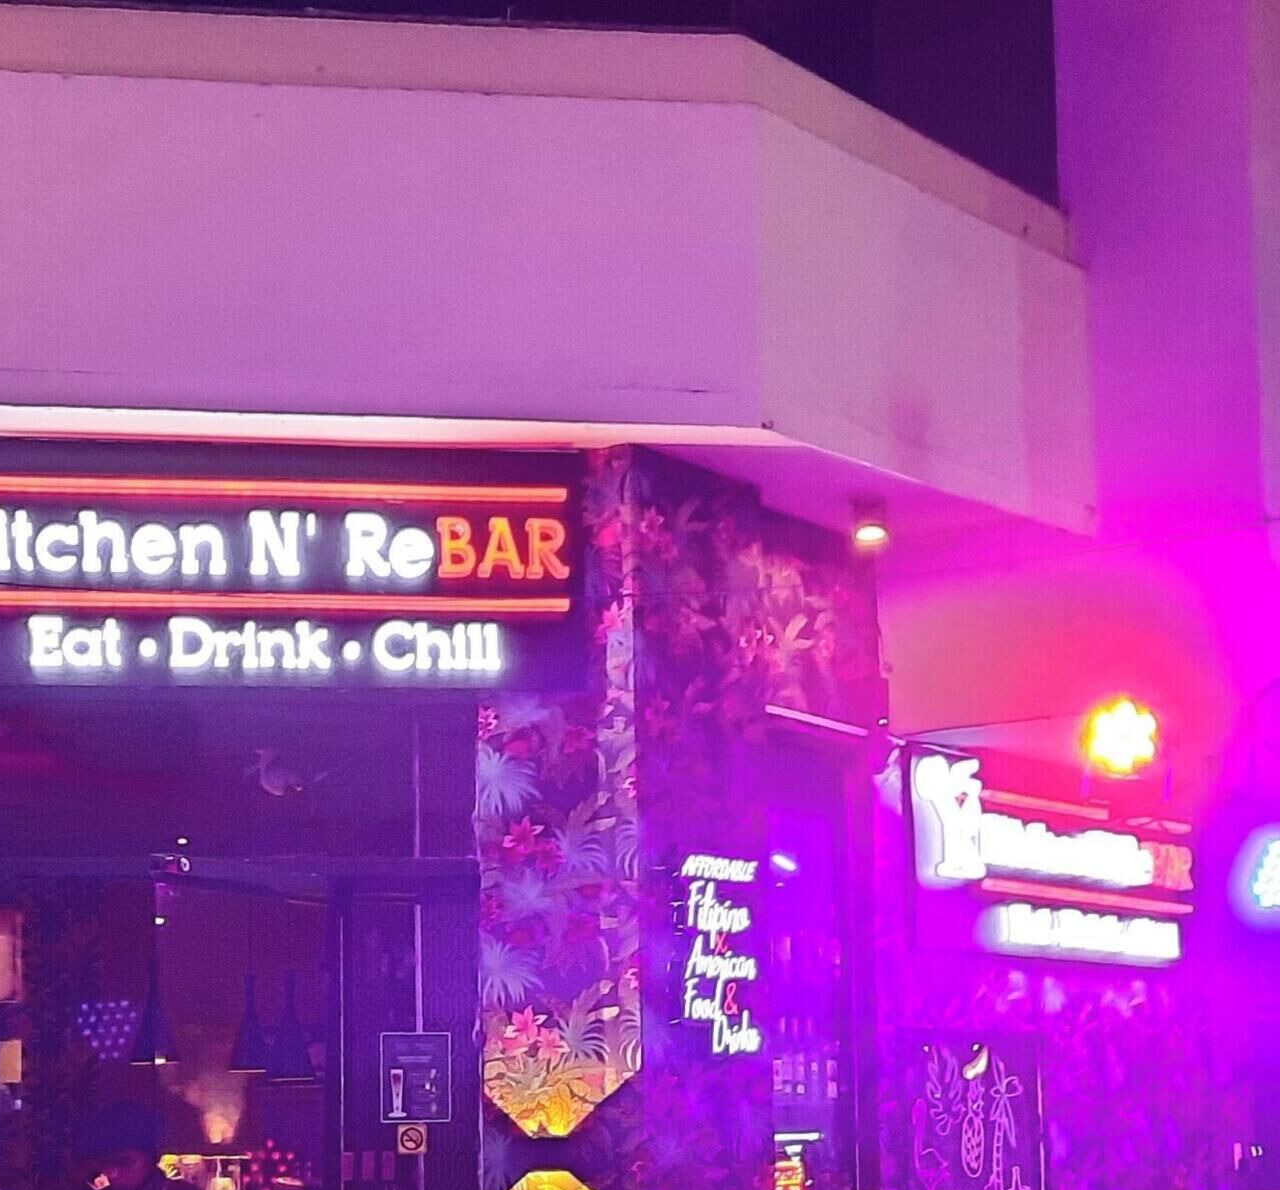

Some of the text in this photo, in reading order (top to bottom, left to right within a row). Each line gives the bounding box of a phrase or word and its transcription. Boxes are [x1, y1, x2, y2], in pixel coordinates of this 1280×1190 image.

[249, 511, 316, 577] N'
[346, 513, 571, 581] ReBAR
[29, 615, 503, 674] Eat Drink Chill
[681, 854, 759, 883] AFFORDABLE
[684, 934, 757, 981] American
[684, 976, 738, 1020] Food &
